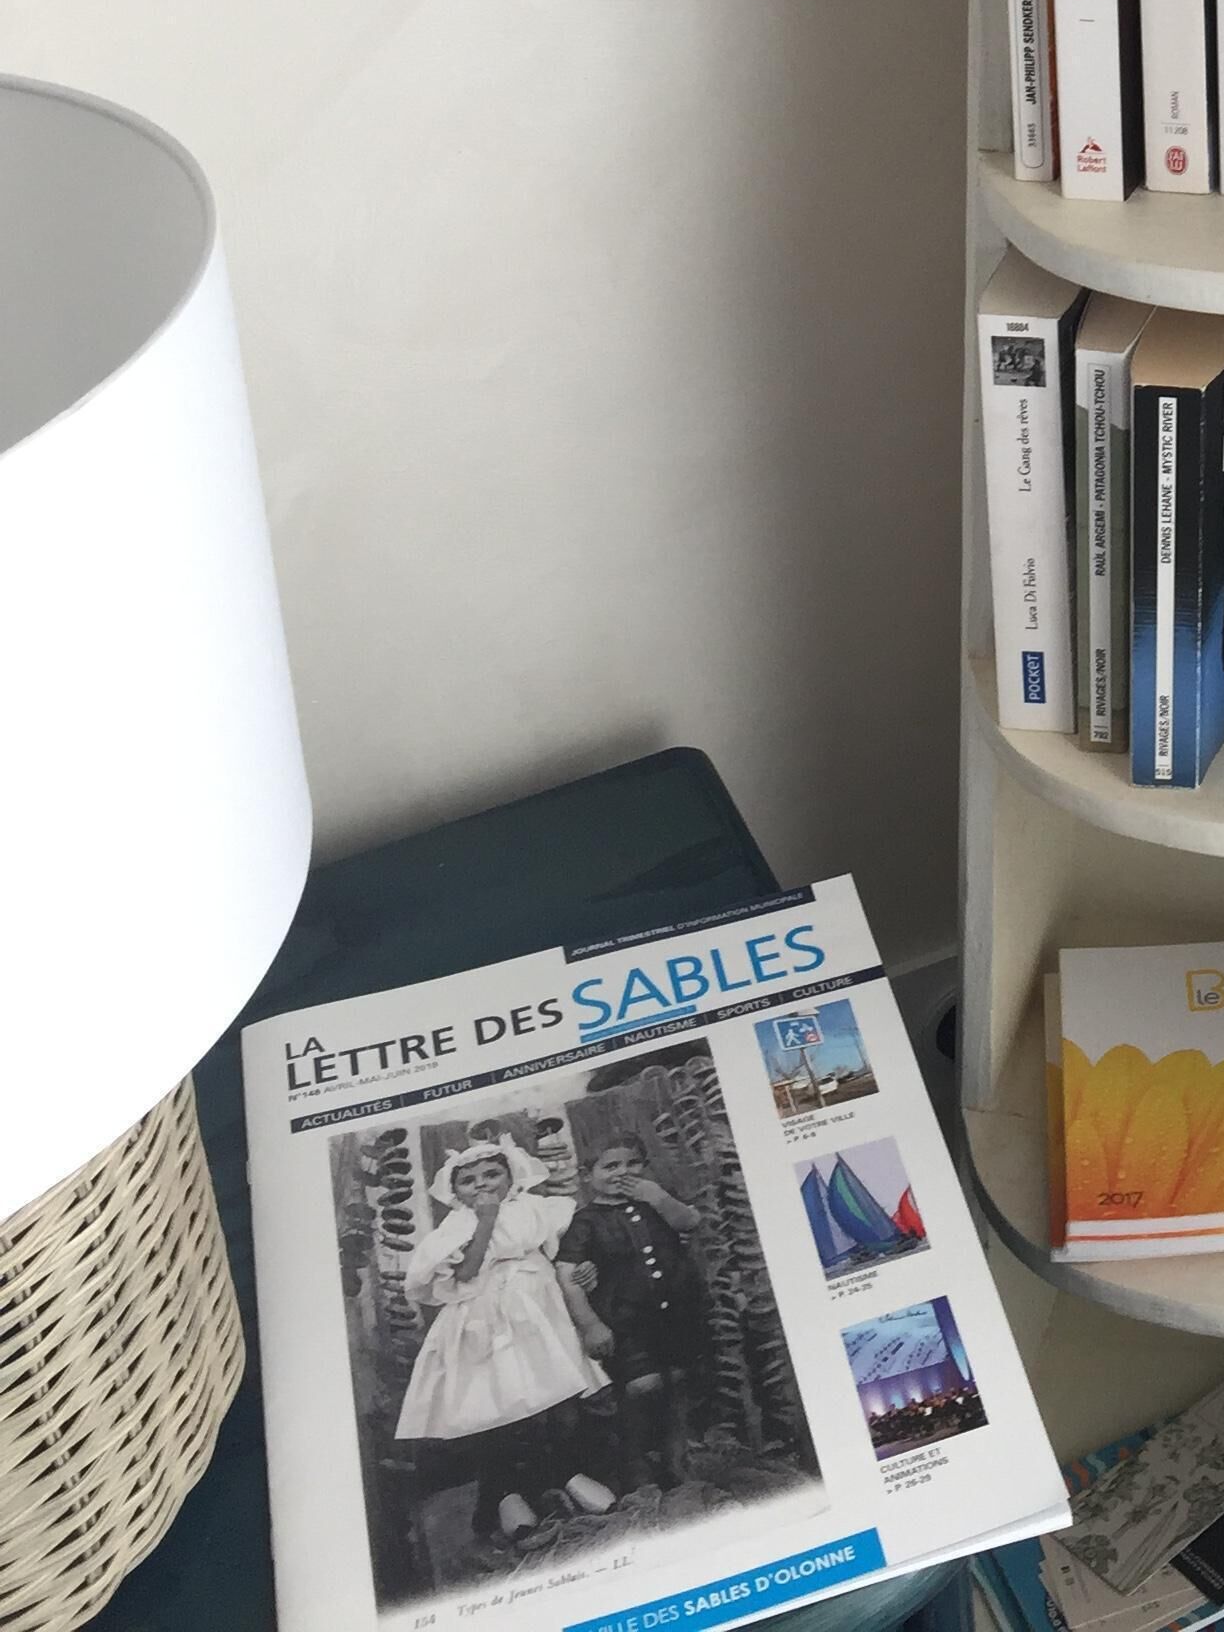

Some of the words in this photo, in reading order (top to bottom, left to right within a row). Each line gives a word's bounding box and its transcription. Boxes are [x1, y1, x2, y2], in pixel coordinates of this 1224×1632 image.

[1022, 0, 1035, 44] SENDKER
[1023, 46, 1037, 105] JAN-PHILIPP
[1015, 398, 1028, 425] rêves
[1093, 369, 1106, 441] TCHOU-TCHOU
[1163, 401, 1174, 433] RIVER
[1016, 426, 1031, 445] des
[1017, 447, 1032, 476] Gang
[1161, 435, 1174, 475] MYSTIC
[1018, 477, 1032, 492] Le
[1094, 443, 1106, 502] PATAGONIA
[1160, 483, 1173, 525] LEHANE
[1160, 526, 1172, 564] DENNIS
[1022, 558, 1037, 587] Fulvio
[1023, 589, 1038, 604] Di
[1025, 606, 1038, 630] Luca
[1095, 648, 1106, 717] RIVAGES/NOIR
[1157, 694, 1170, 758] RIVAGES/NOIR
[571, 938, 616, 957] JOURNAL
[287, 1025, 457, 1091] LETTRE
[473, 998, 564, 1046] DES
[571, 925, 826, 1031] SABLES
[285, 1036, 326, 1061] LA
[301, 1098, 393, 1129] ACTUALITÉS
[422, 1079, 473, 1100] FUTUR
[502, 1043, 607, 1079] ANNIVERSAIRE
[623, 1018, 697, 1045] NAUTISME
[716, 997, 771, 1020] SPORTS
[792, 976, 854, 1000] CULTURE
[830, 1111, 855, 1123] VILLE
[1097, 1190, 1145, 1210] 2017
[880, 1452, 927, 1474] CULTURE
[928, 1447, 941, 1458] ET
[883, 1456, 950, 1484] ANIMATIONS
[642, 1604, 680, 1629] DES
[683, 1581, 752, 1618] SABLES
[754, 1544, 857, 1594] D'OLONNE
